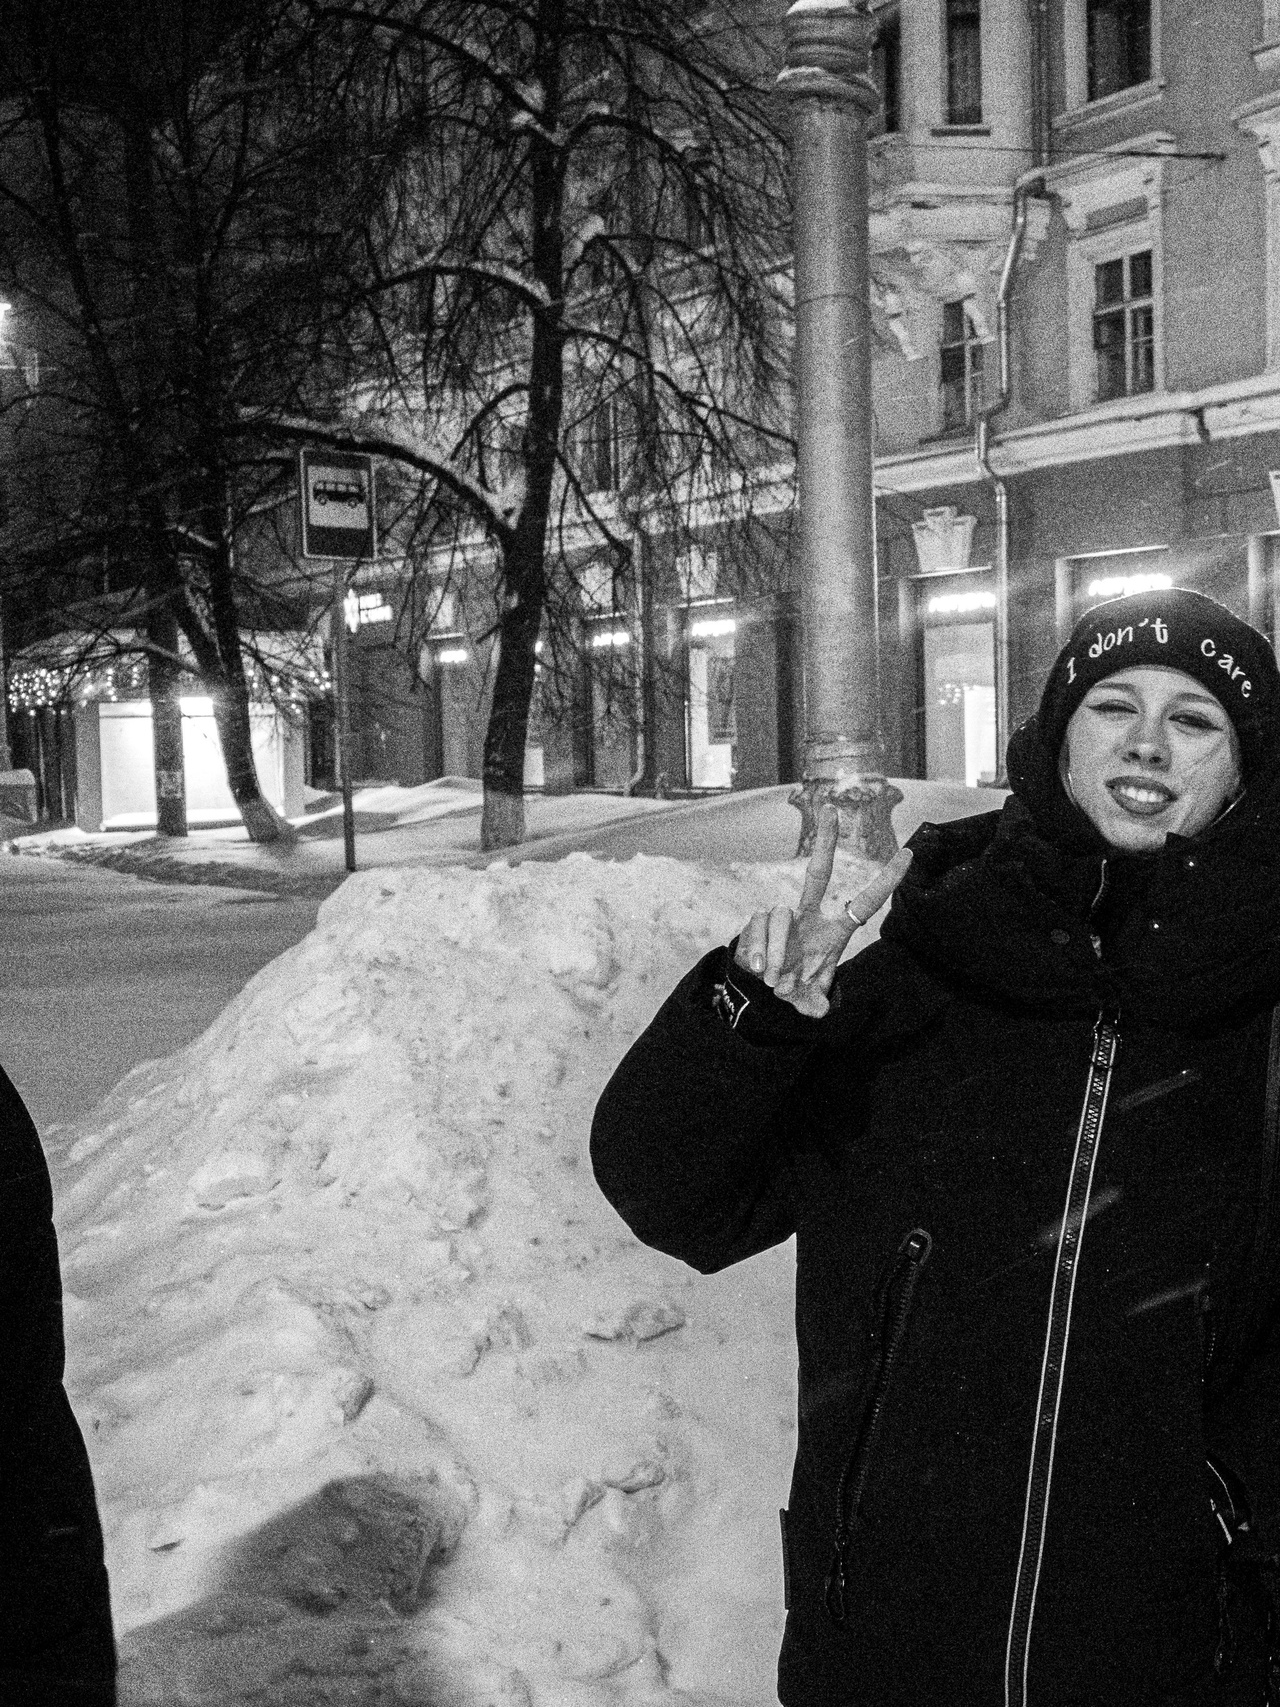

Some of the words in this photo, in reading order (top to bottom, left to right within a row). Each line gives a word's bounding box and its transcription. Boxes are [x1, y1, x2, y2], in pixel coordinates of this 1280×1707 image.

[1066, 656, 1077, 684] I
[1088, 617, 1169, 659] don't
[1201, 638, 1252, 698] care
